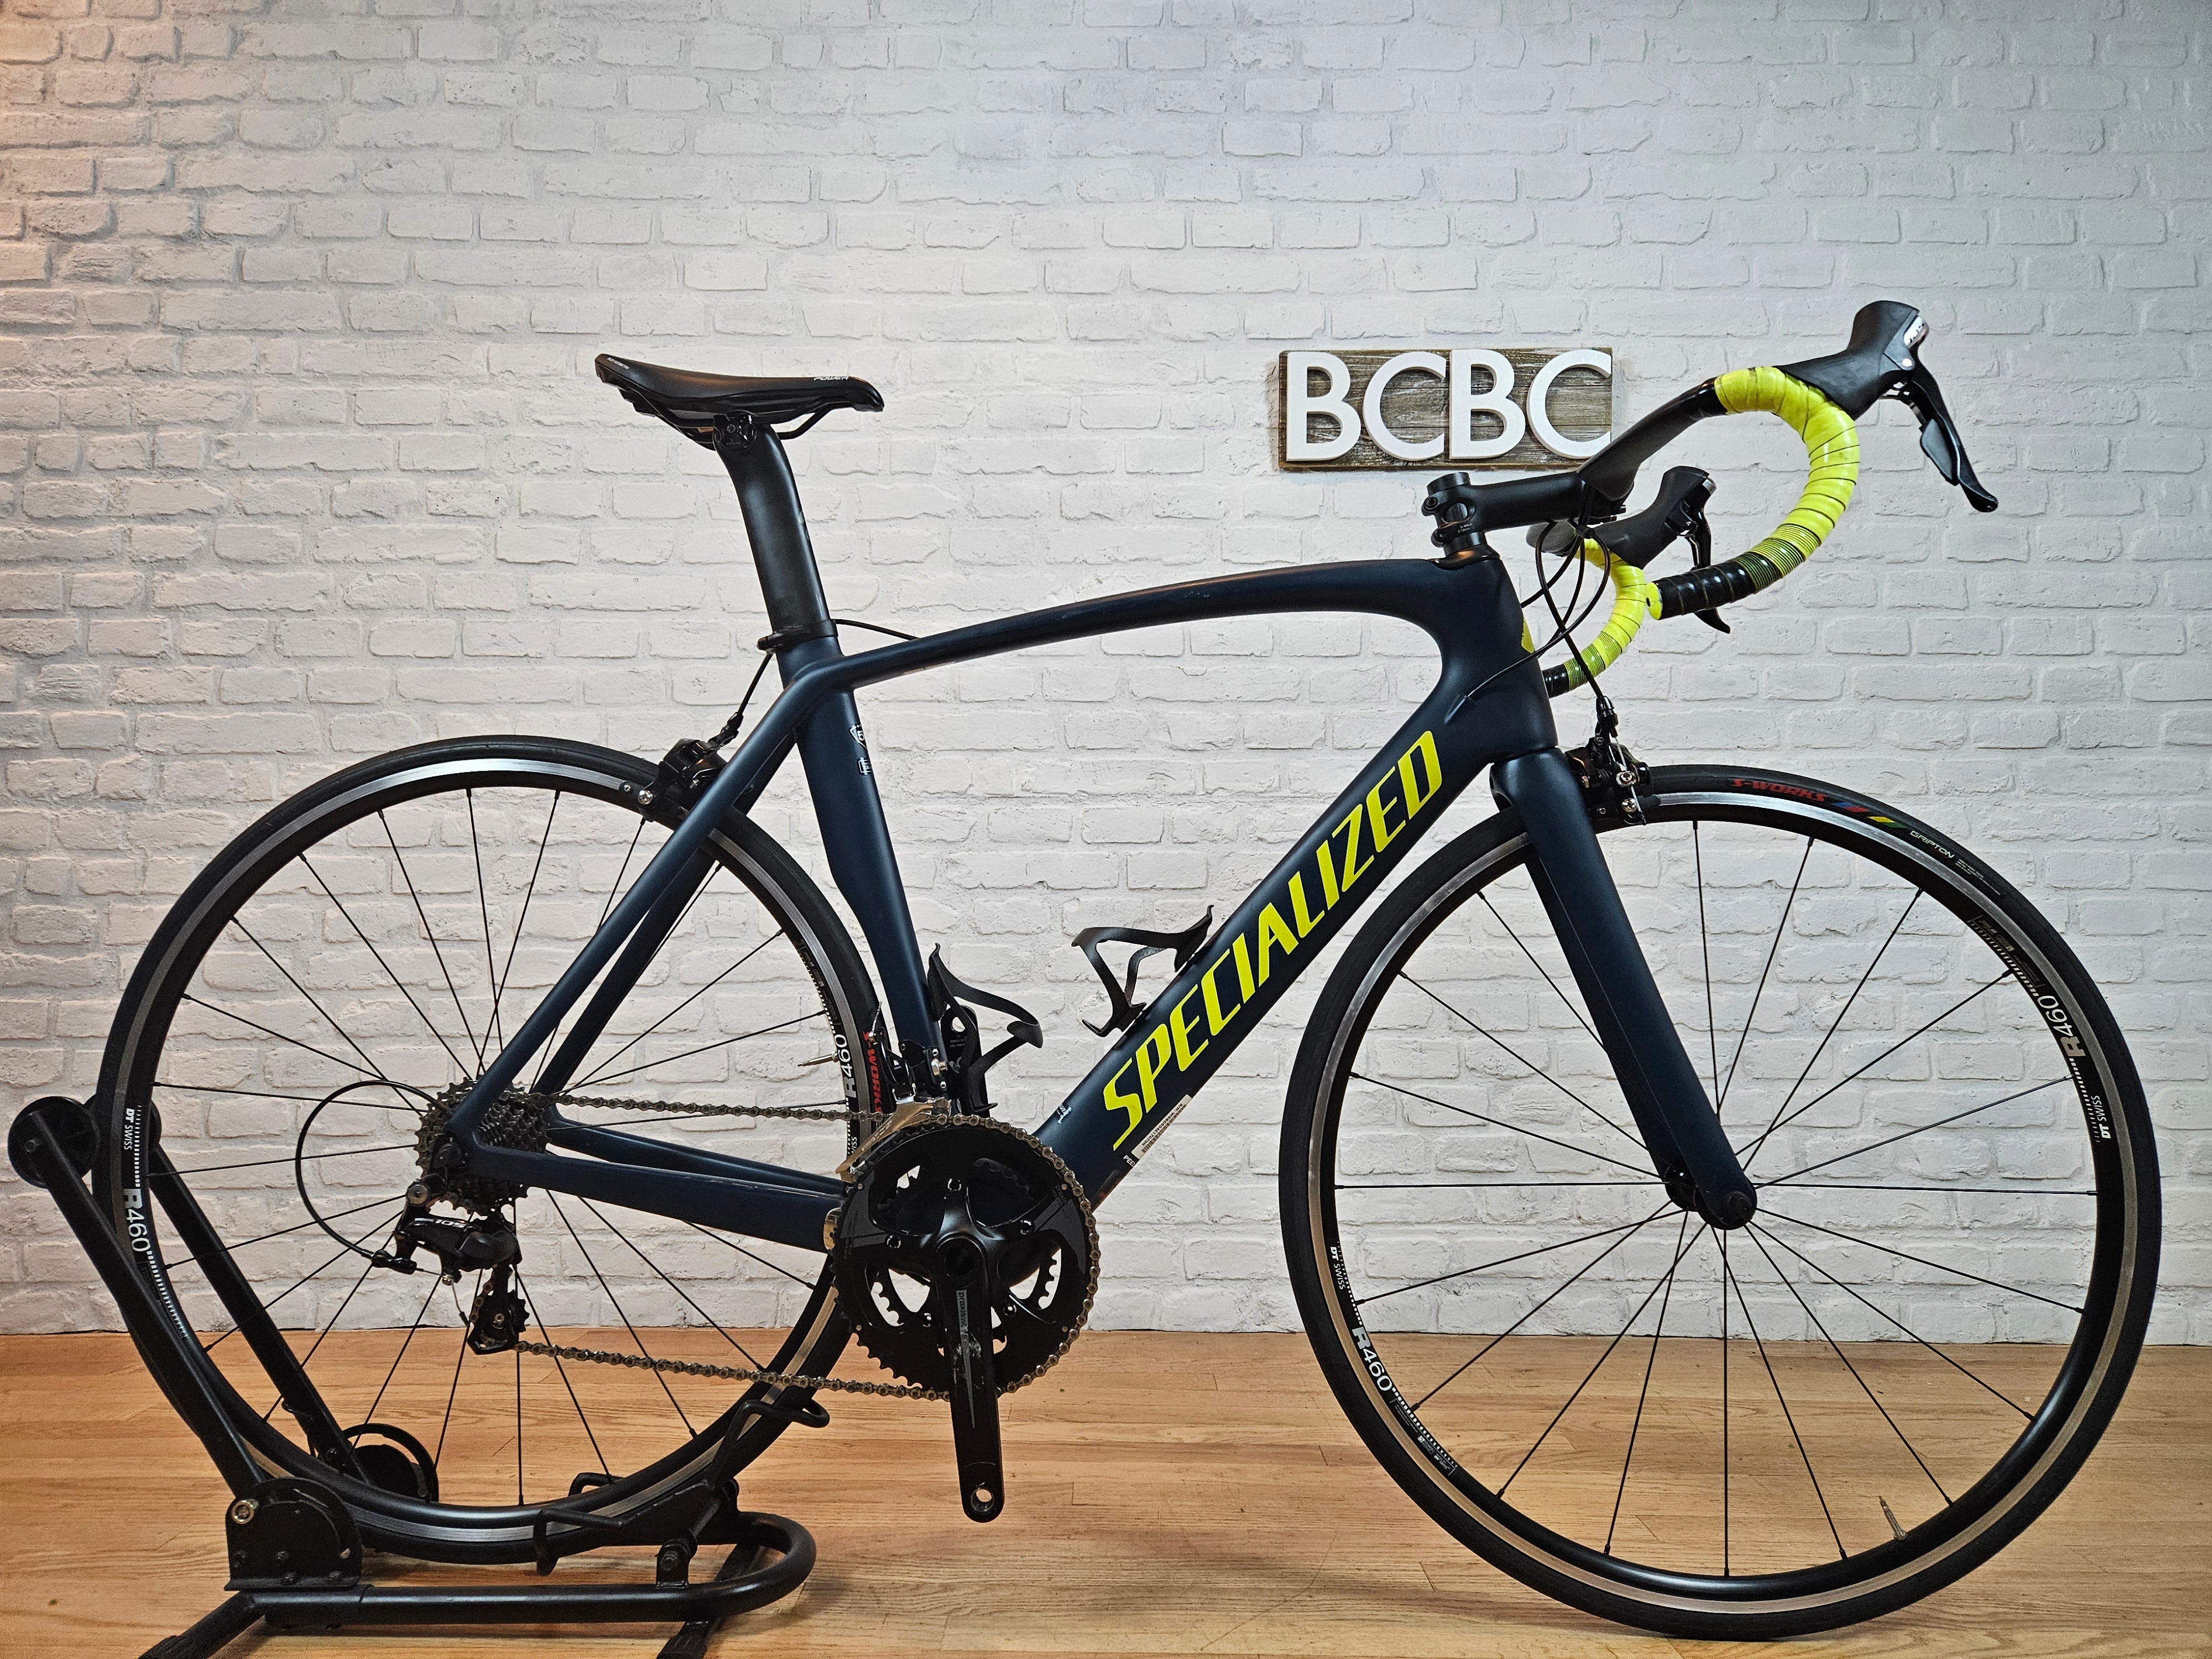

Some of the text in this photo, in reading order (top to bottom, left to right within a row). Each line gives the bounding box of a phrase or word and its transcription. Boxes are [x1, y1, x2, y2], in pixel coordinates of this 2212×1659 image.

[1286, 348, 1612, 462] BCBC
[1730, 778, 1828, 802] S-WORKS
[1910, 830, 1955, 858] GRIPTON
[1103, 729, 1442, 1151] SPECIALIZED
[2037, 995, 2086, 1056] R460
[834, 1034, 857, 1098] R460
[863, 1030, 882, 1113] S-WORKS
[124, 1108, 135, 1150] DT SWISS
[2090, 1094, 2111, 1139] DT SWISS
[123, 1188, 152, 1252] R460
[435, 1219, 467, 1228] 105
[1330, 1246, 1346, 1290] DT SWISS
[1352, 1326, 1392, 1391] R460
